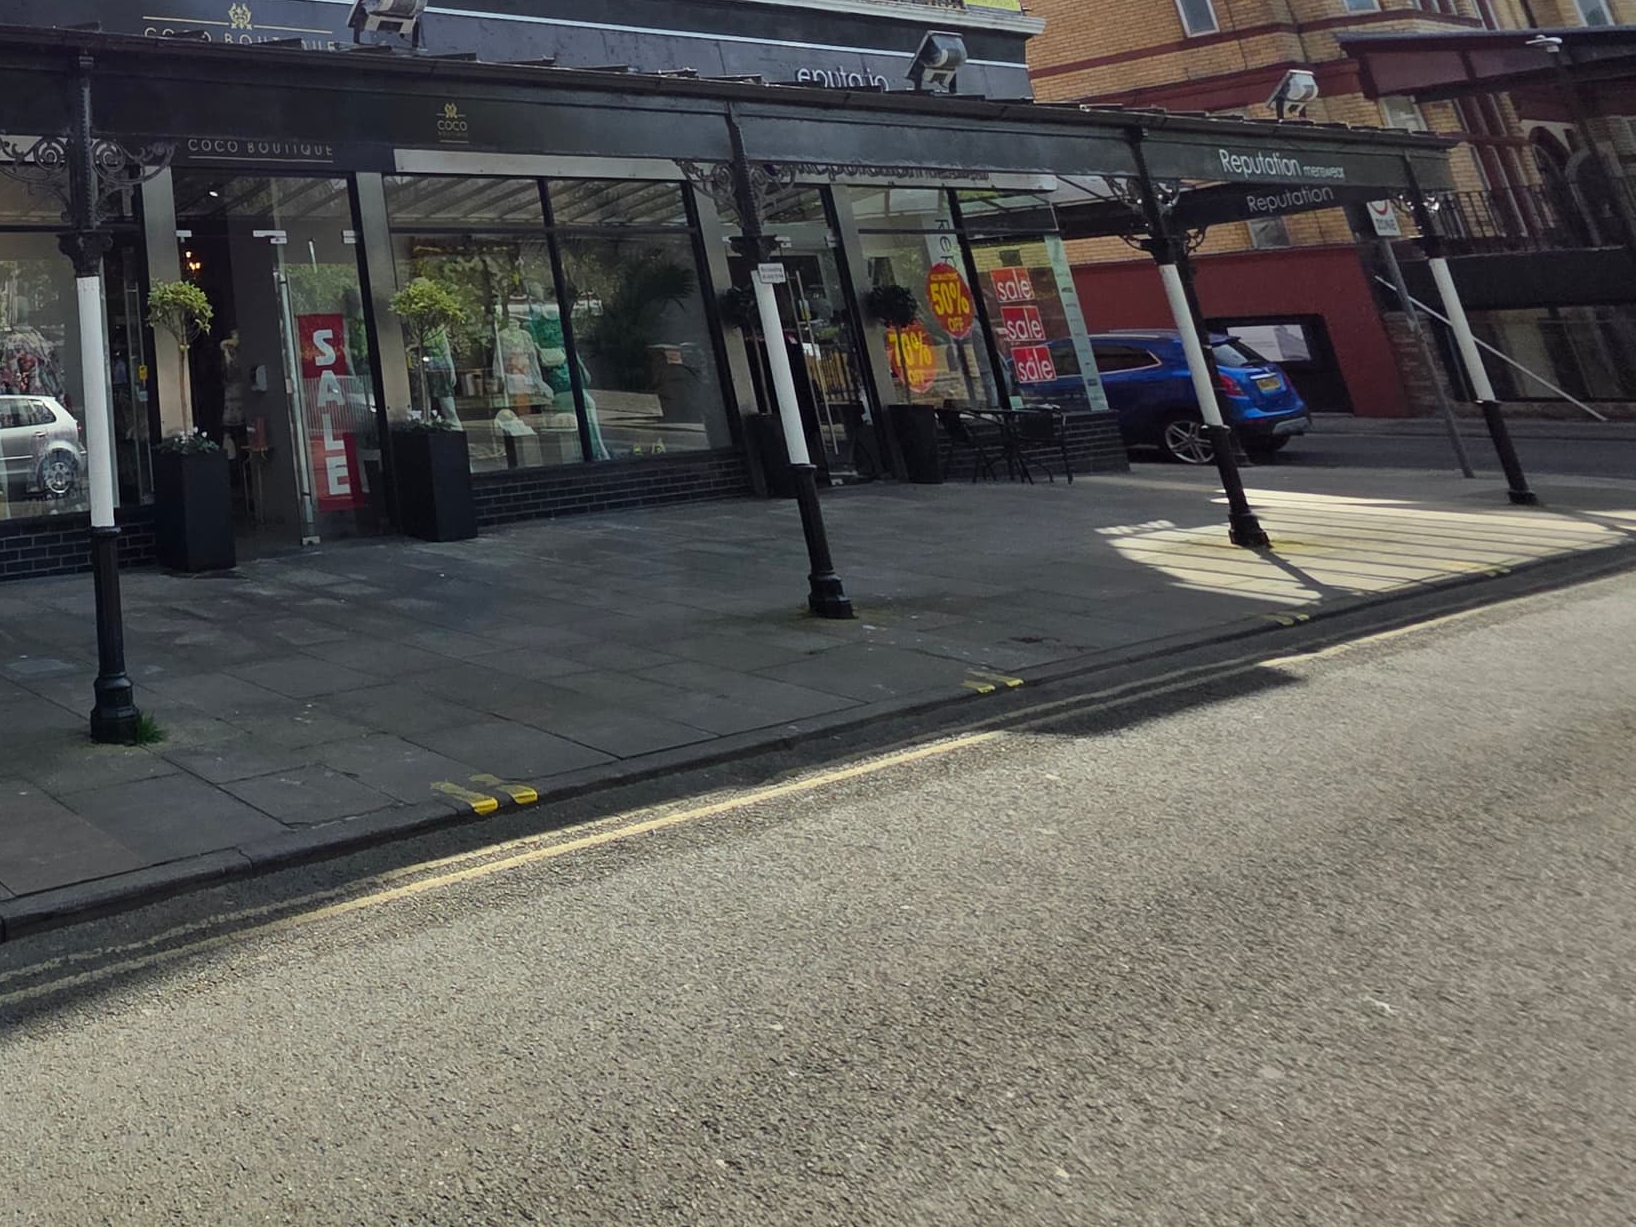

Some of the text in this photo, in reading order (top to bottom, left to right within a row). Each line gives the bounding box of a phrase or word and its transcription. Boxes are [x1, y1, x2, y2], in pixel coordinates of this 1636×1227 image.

[437, 120, 468, 131] COCO
[187, 139, 238, 152] COCO
[1218, 149, 1302, 179] Reputation
[1246, 185, 1334, 214] Reputation
[930, 281, 970, 316] 50%
[997, 271, 1032, 301] sale
[947, 316, 964, 332] OFF
[1007, 309, 1043, 340] sale
[1018, 350, 1053, 381] sale
[313, 329, 352, 495] SALE
